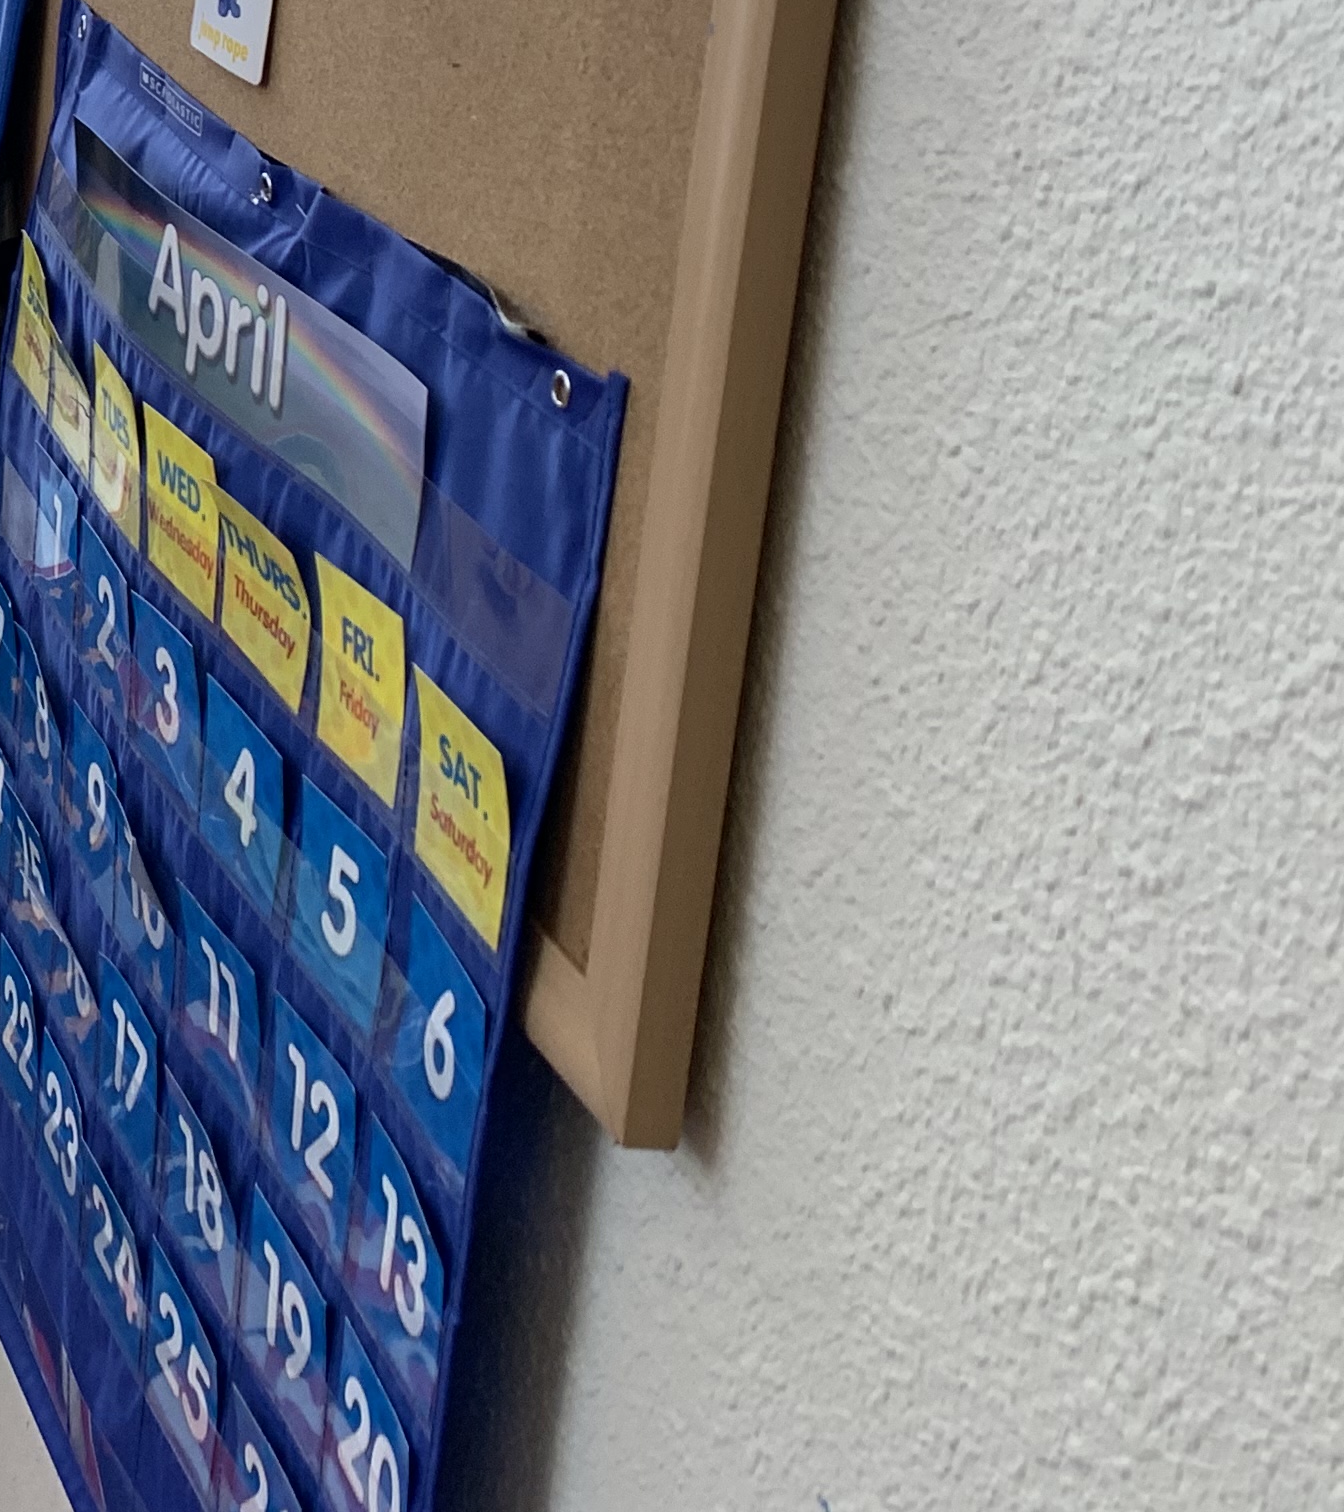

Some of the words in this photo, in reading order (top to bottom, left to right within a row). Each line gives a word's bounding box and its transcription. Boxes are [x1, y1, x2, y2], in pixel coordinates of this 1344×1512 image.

[222, 37, 249, 65] rope
[147, 71, 203, 131] SCHOLASTIC
[147, 222, 290, 413] April
[157, 448, 208, 524] WED.
[147, 494, 214, 582] Wednesday
[232, 572, 297, 661] Thursday
[341, 615, 381, 684] FRI.
[337, 678, 380, 743] Friday
[52, 492, 64, 579] 1
[96, 574, 117, 671] 2
[154, 645, 181, 746] 3
[222, 745, 258, 848] 4
[320, 842, 361, 959] 5
[422, 988, 457, 1101] 6
[438, 733, 489, 822] SAT.
[429, 790, 495, 890] Saturday
[34, 675, 51, 759] 8
[86, 762, 108, 851] 9
[200, 934, 240, 1065] 11
[286, 1042, 340, 1201] 12
[378, 1173, 428, 1338] 13
[0, 973, 36, 1093] 22
[43, 1069, 80, 1197] 23
[91, 1181, 140, 1326] 24
[153, 1291, 212, 1444] 25
[112, 998, 149, 1113] 17
[177, 1113, 226, 1253] 18
[262, 1238, 313, 1380] 19
[336, 1373, 401, 1512] 20
